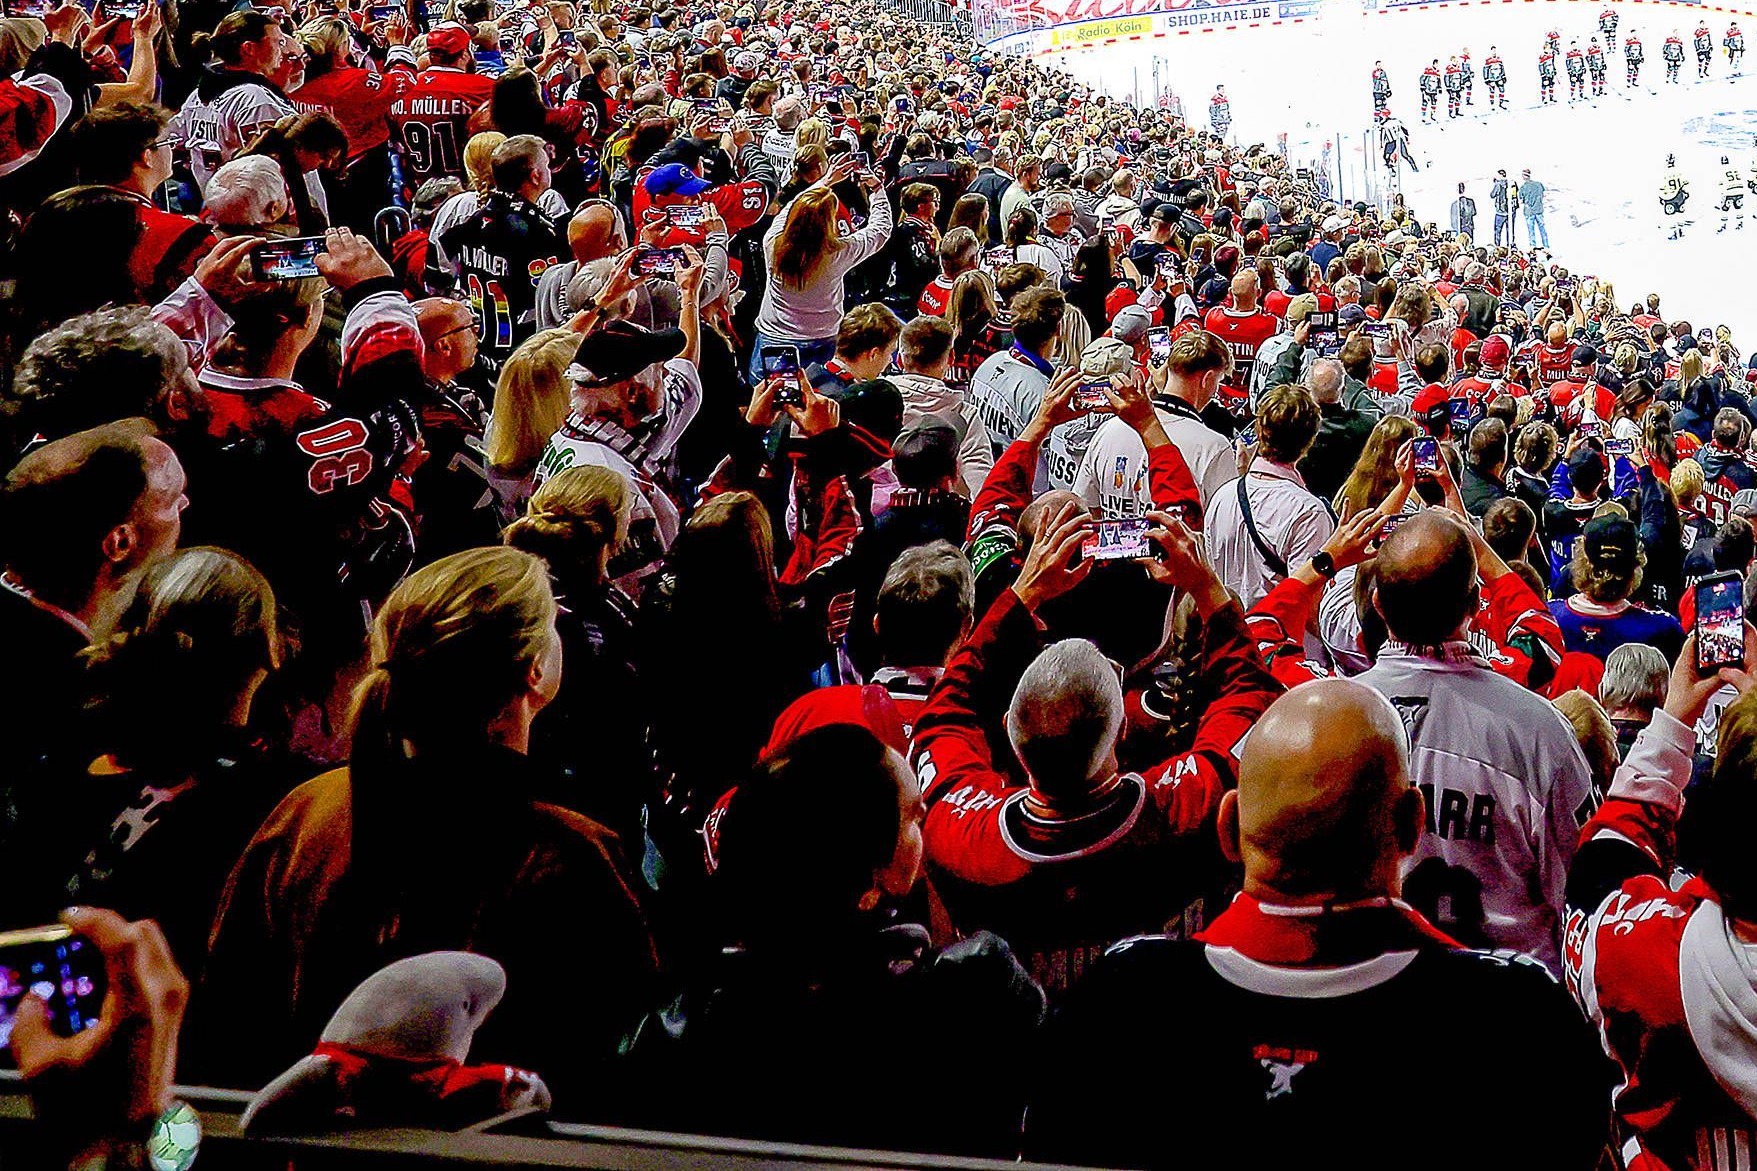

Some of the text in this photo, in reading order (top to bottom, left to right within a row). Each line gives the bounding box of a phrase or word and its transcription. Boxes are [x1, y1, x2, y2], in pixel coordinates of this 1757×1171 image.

[1168, 7, 1271, 28] SHOP.HAIE.DE
[1077, 21, 1142, 41] Radio Köln
[412, 96, 473, 116] MÜLLER
[402, 121, 461, 173] 91
[296, 418, 373, 495] 30
